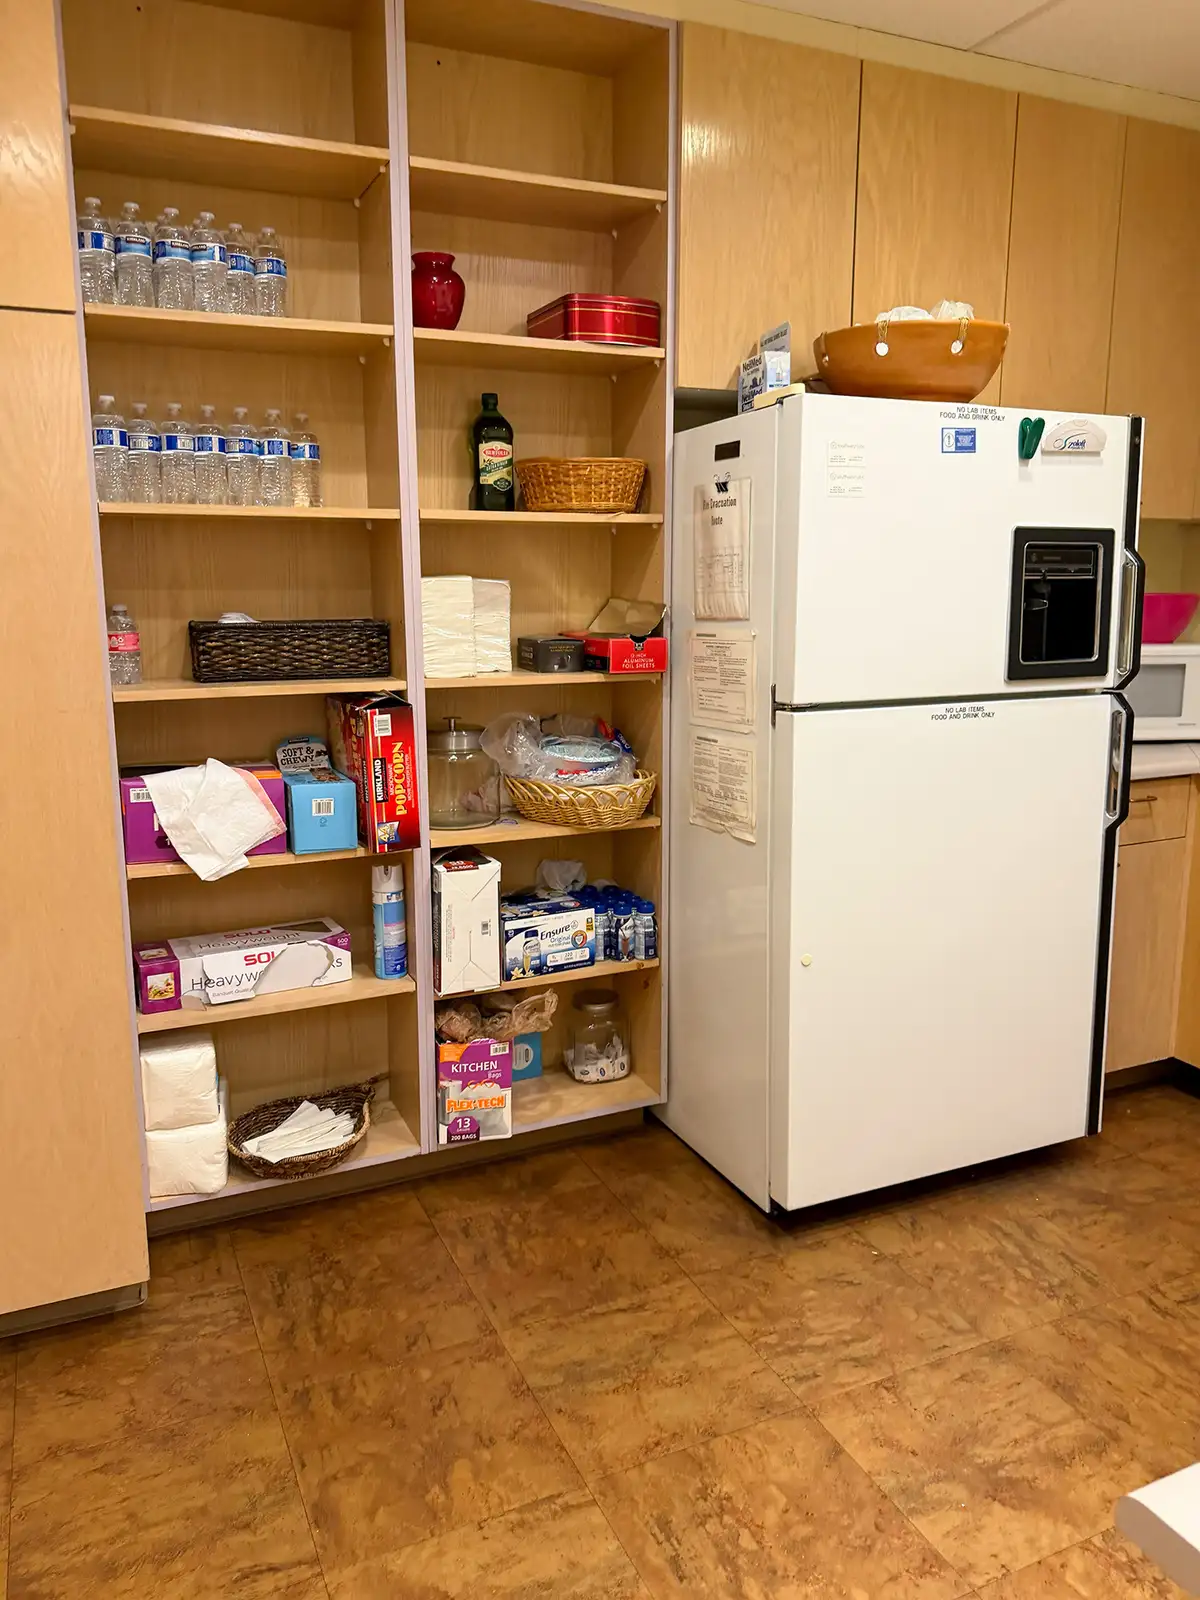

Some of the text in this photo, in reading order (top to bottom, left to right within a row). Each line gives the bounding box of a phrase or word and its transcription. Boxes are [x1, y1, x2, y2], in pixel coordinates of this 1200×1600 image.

[939, 411, 956, 419] FOOD
[931, 713, 948, 721] FOOD
[949, 712, 962, 720] AND
[962, 711, 980, 719] DRINK
[282, 746, 315, 758] SOFT &
[280, 755, 315, 766] CHEWY
[374, 759, 384, 802] KIRKLAND
[391, 741, 408, 816] POPCORN
[379, 825, 390, 843] 44
[223, 929, 271, 939] SOLO
[540, 923, 571, 941] Ensure
[199, 932, 302, 950] Heavyweight
[550, 935, 571, 944] Original
[451, 1060, 498, 1073] KITCHEN
[487, 1071, 502, 1079] Bags
[456, 1117, 471, 1129] 13
